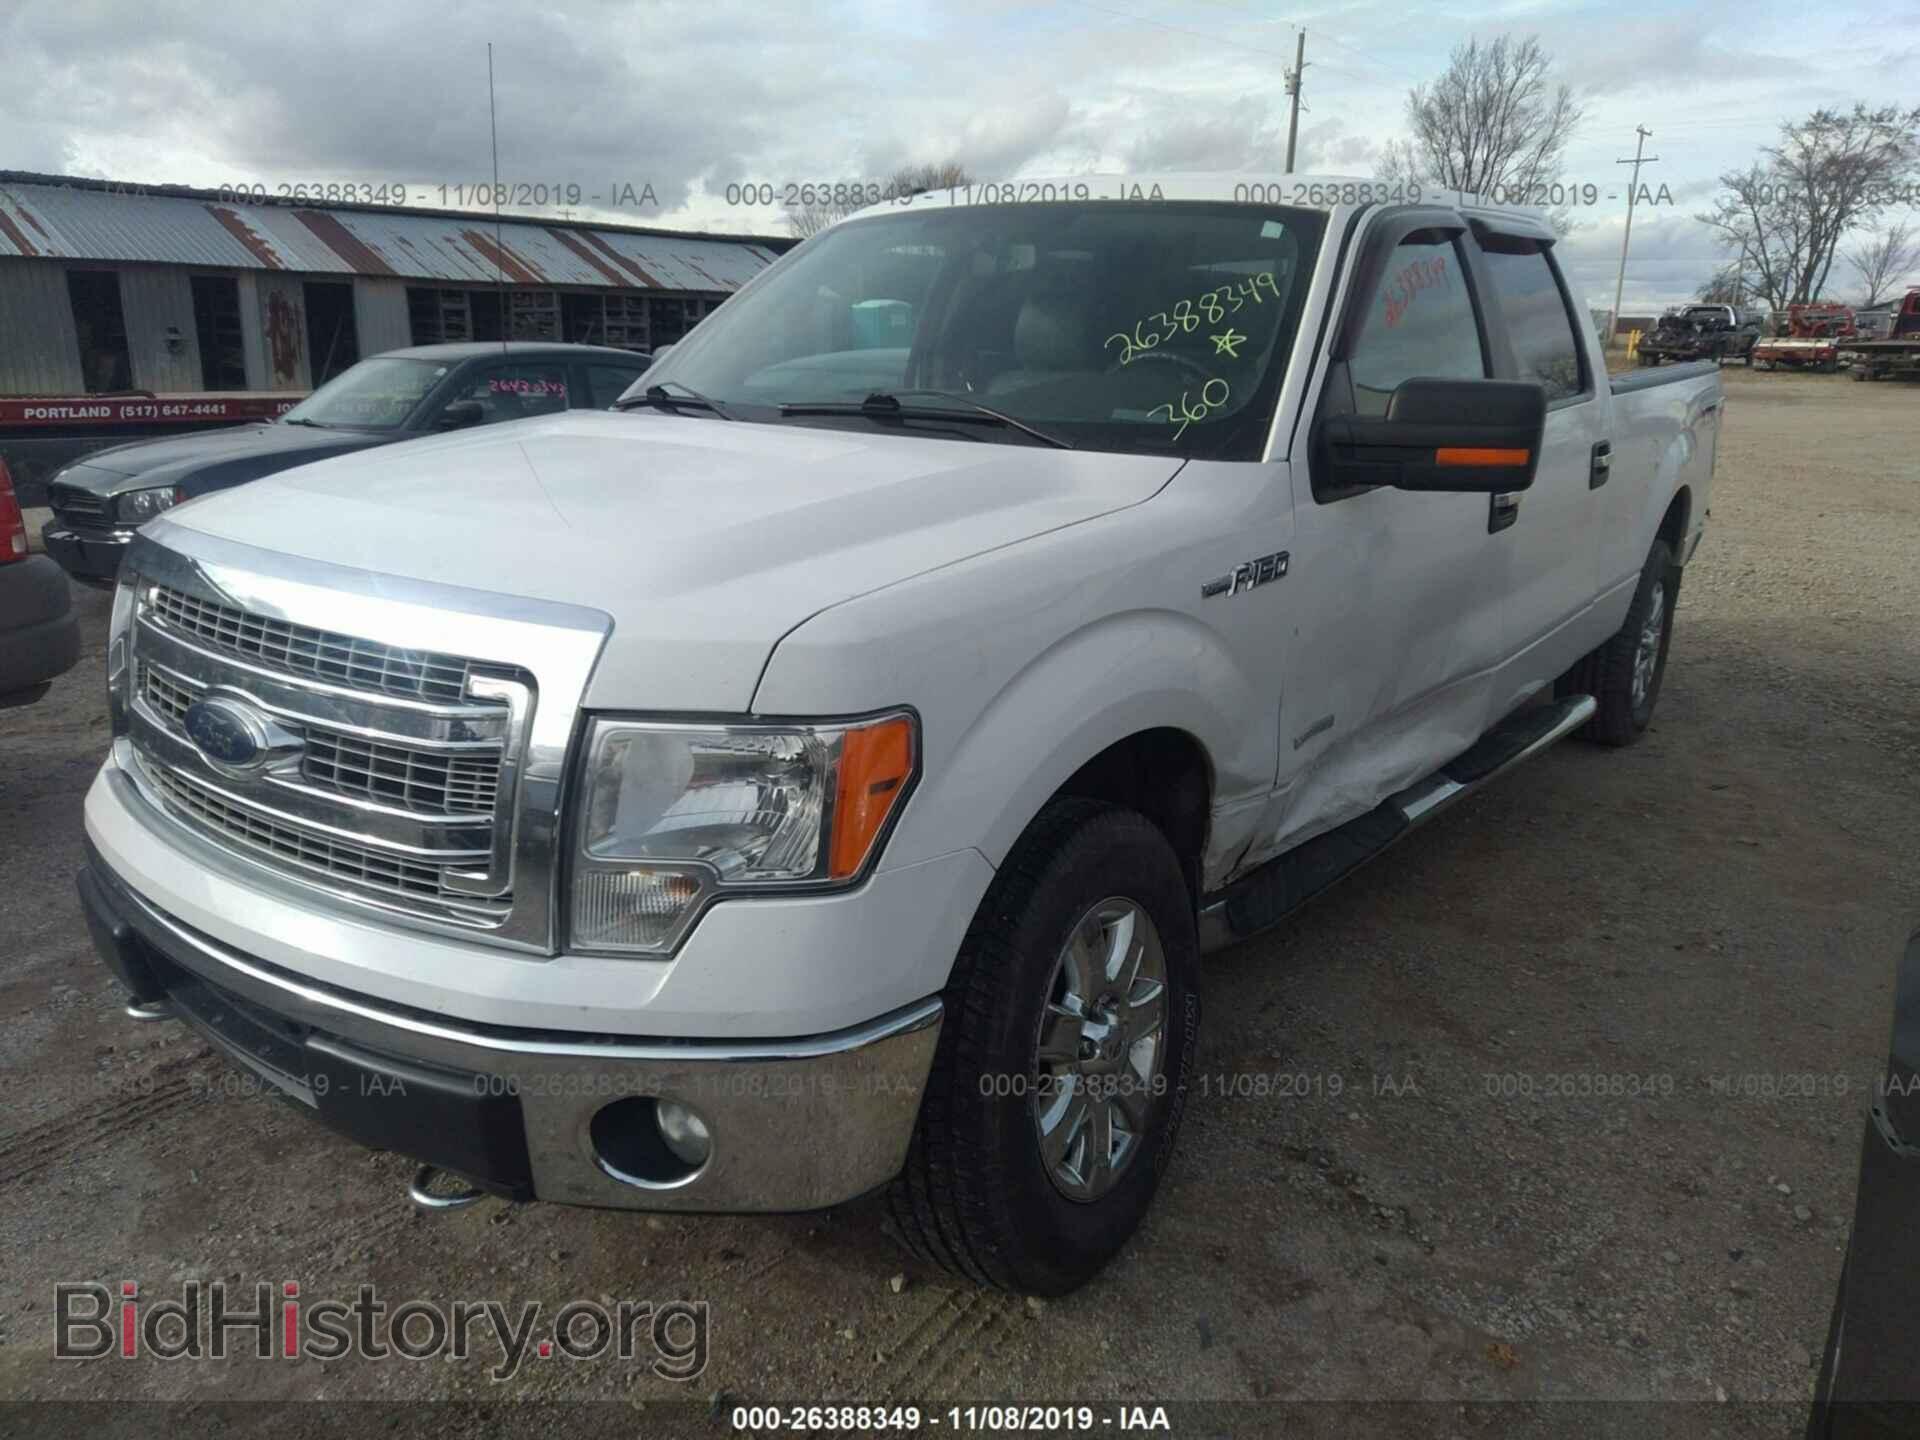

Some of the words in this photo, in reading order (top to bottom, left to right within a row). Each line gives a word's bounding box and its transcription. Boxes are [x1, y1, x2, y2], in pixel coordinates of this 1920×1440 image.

[1104, 272, 1280, 365] 26388349
[23, 406, 111, 419] PORTLAND
[119, 406, 158, 418] (517)
[162, 404, 226, 415] 647-4441
[1147, 378, 1230, 441] 360
